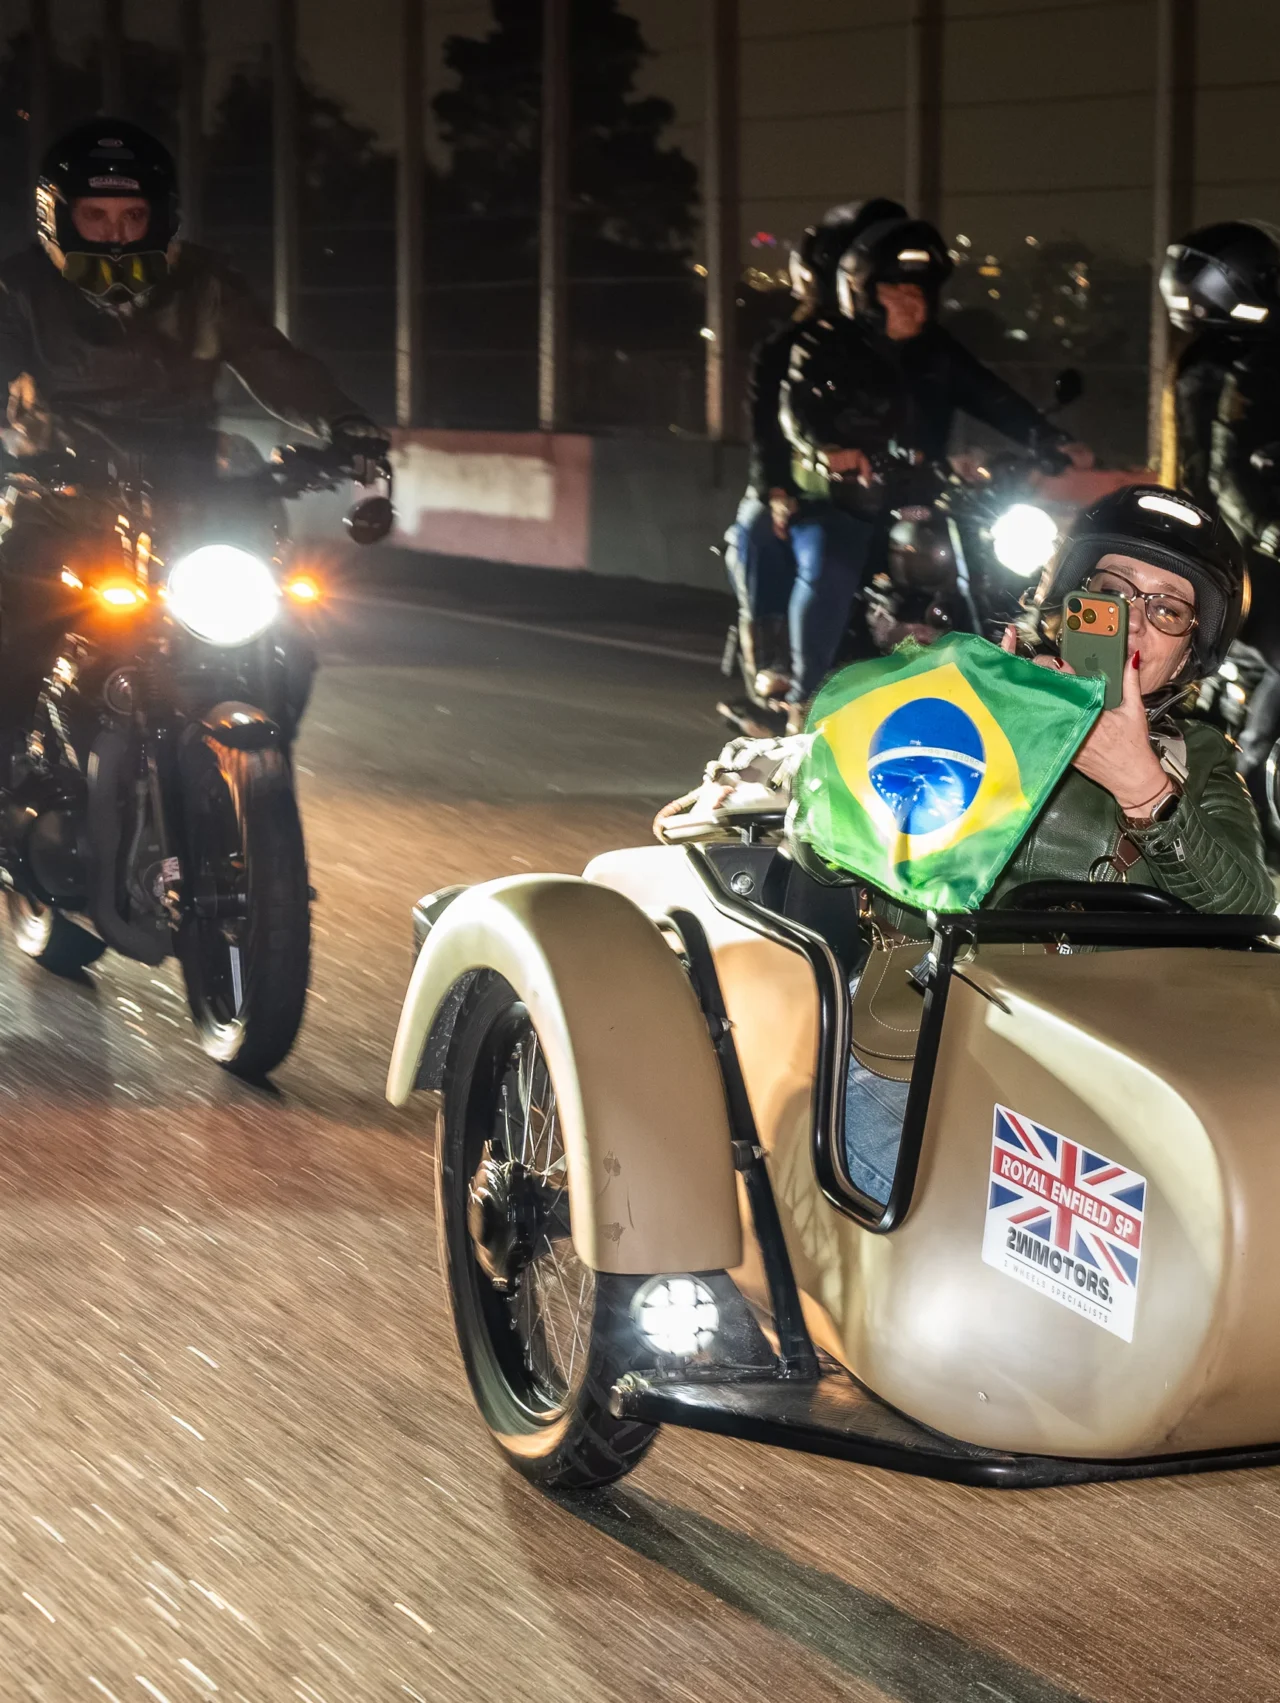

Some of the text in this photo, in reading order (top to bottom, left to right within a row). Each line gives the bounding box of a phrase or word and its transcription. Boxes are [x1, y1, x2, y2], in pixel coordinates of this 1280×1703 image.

[1001, 1153, 1134, 1237] ROYAL ENFIELD SP
[1013, 1264, 1046, 1289] WHEELS
[1051, 1285, 1108, 1324] SPECIALISTS
